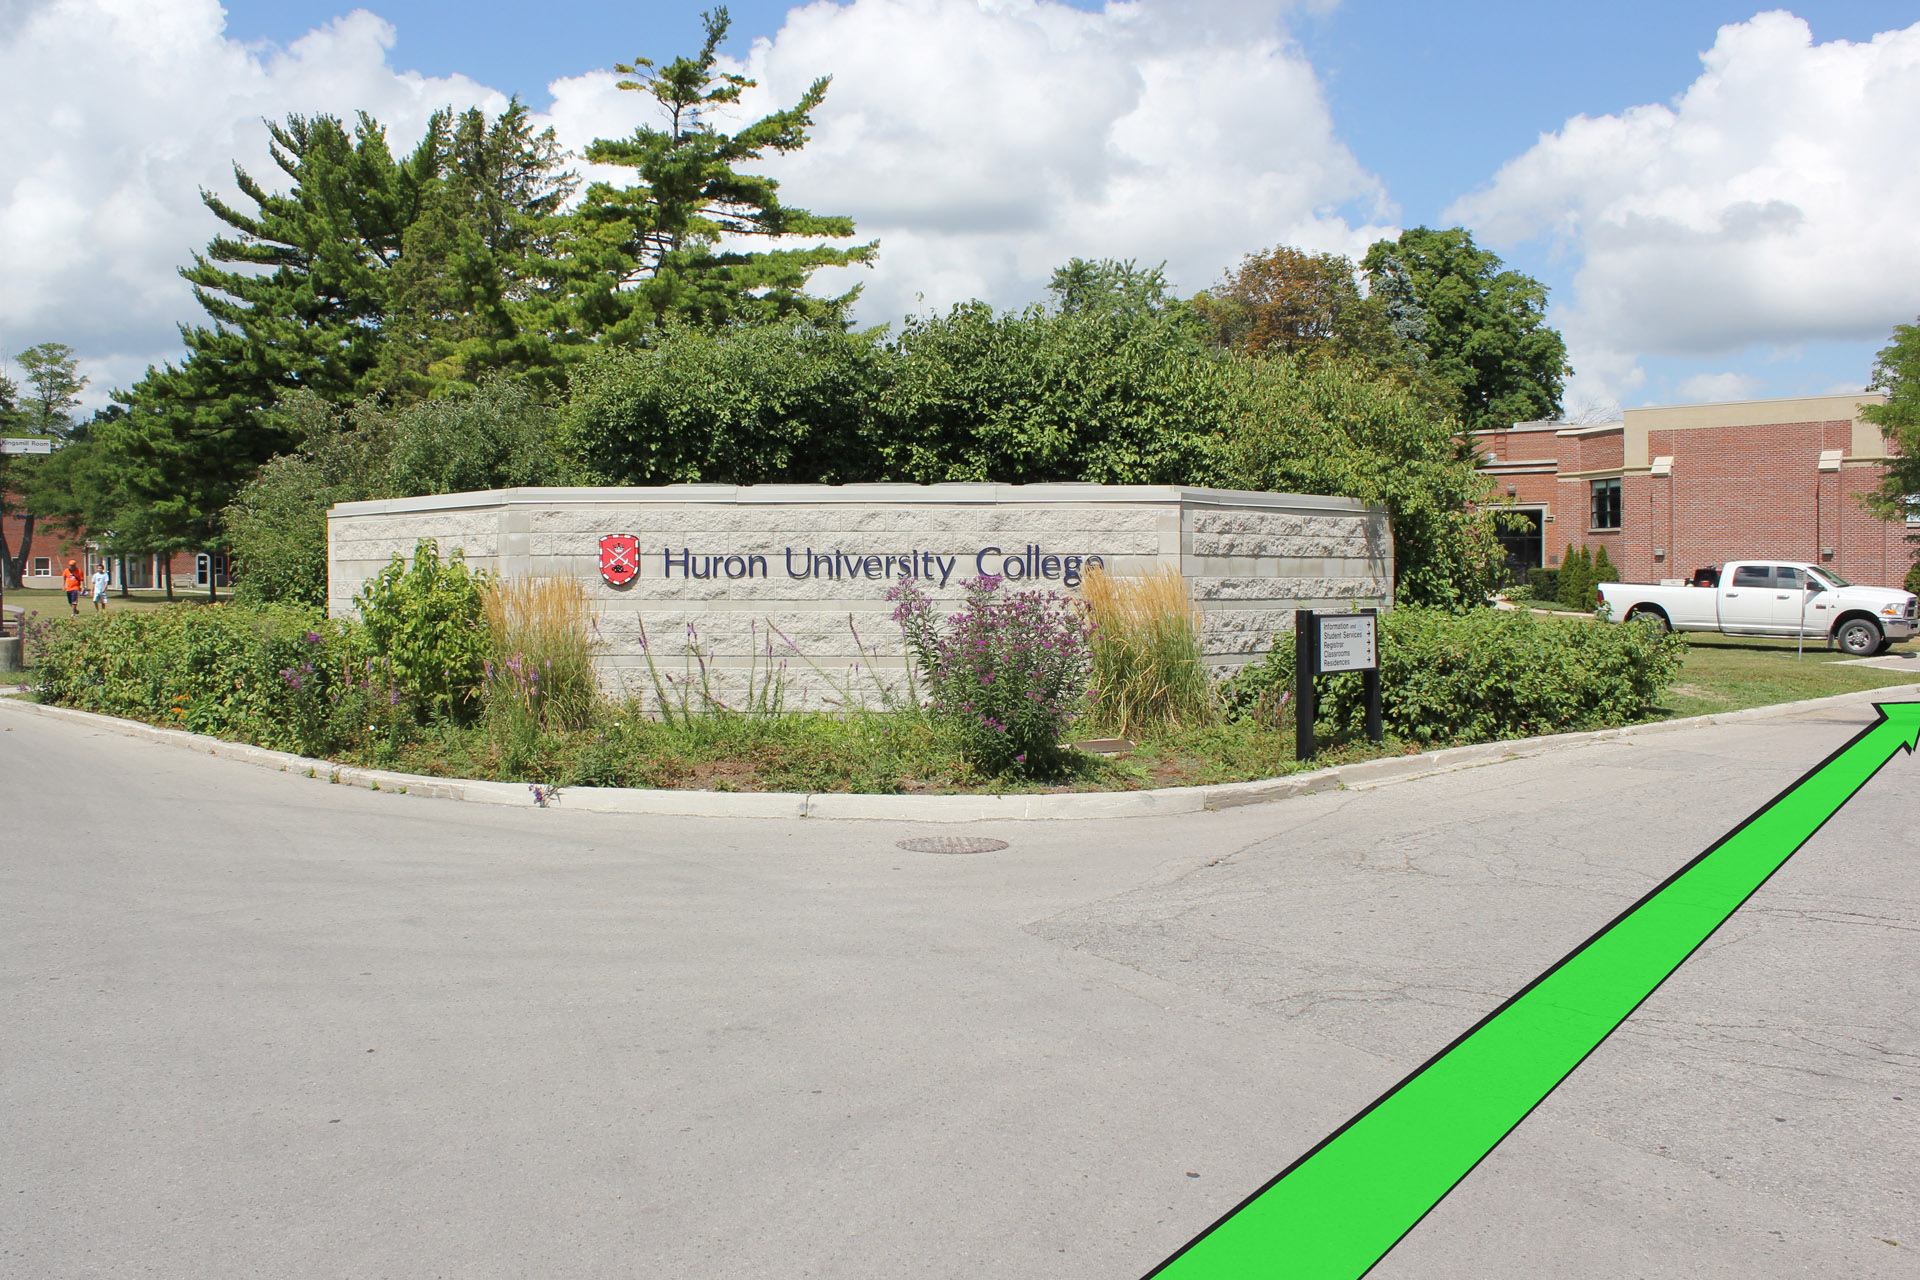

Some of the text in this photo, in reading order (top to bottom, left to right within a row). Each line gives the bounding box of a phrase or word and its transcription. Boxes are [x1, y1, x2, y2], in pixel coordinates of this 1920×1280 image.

[664, 547, 768, 579] Huron
[786, 547, 956, 589] University
[1324, 642, 1344, 650] Registrar
